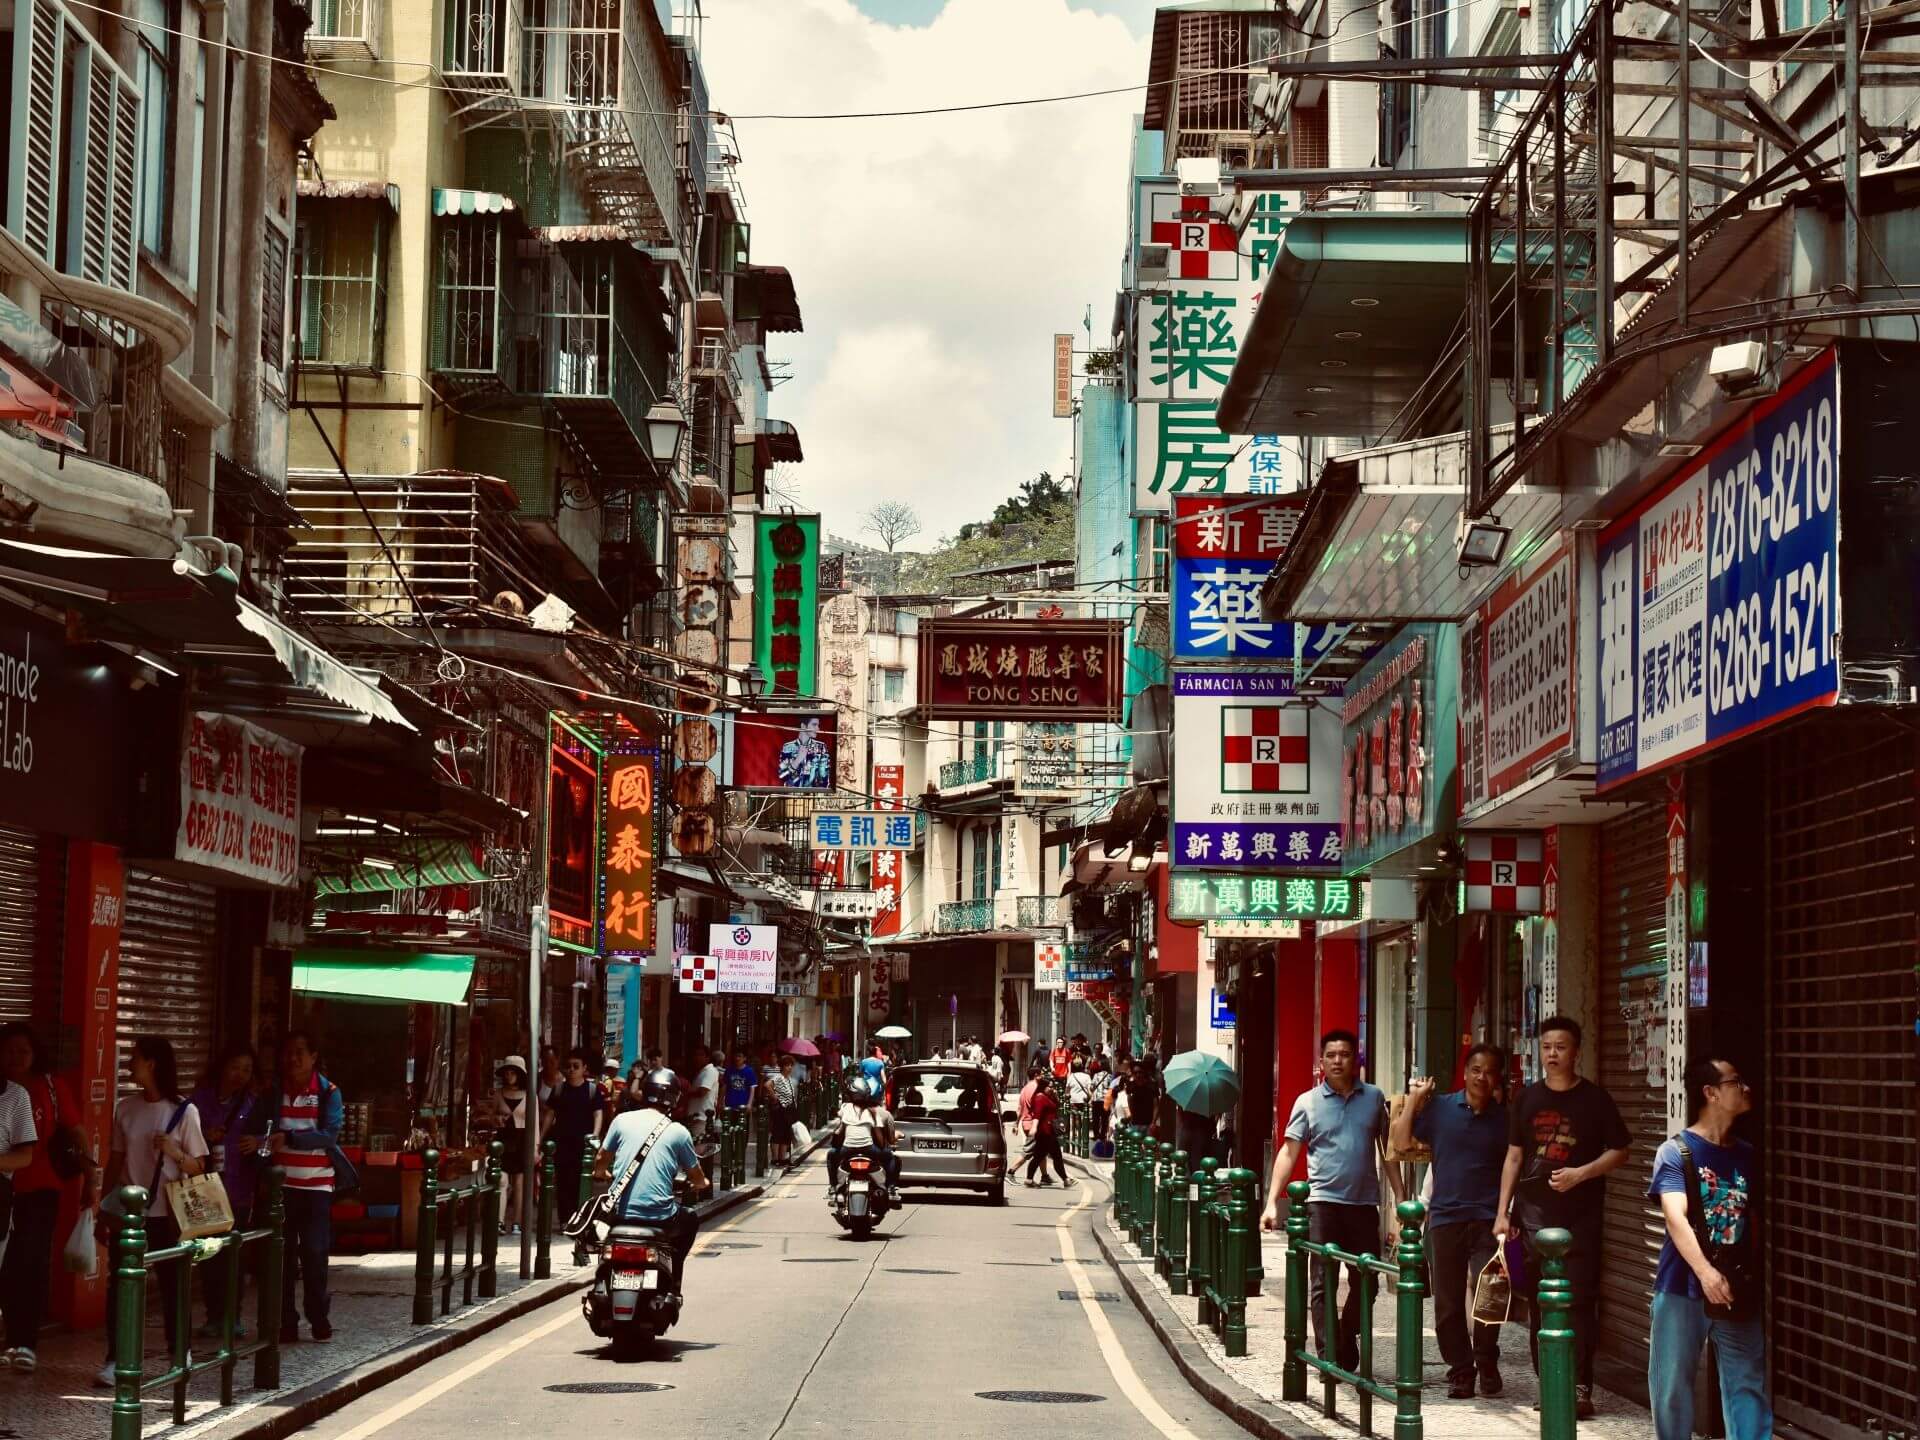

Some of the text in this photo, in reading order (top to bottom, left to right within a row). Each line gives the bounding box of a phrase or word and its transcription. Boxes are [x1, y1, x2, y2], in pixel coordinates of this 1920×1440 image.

[1148, 289, 1238, 496] 藥房
[1709, 397, 1833, 581] 2876-8218
[1679, 556, 1704, 584] PROPERTY
[1508, 563, 1567, 653] 6533-8104
[1709, 552, 1831, 717] 6268-1521
[1508, 621, 1567, 706] 6538-2043
[968, 686, 1078, 702] FONG SENG
[1250, 679, 1274, 690] SAN
[3, 697, 33, 773] Lab
[1508, 678, 1567, 759] 6617-0885
[1600, 730, 1614, 762] FOR
[1616, 721, 1634, 752] RENT
[1210, 801, 1320, 817] 政府註冊藥劑師
[815, 815, 912, 846] 電訊通
[1186, 830, 1343, 863] 新萬興藥房
[604, 763, 652, 941] 國泰行
[1178, 877, 1351, 915] 新萬興藥房
[1069, 984, 1083, 993] 24
